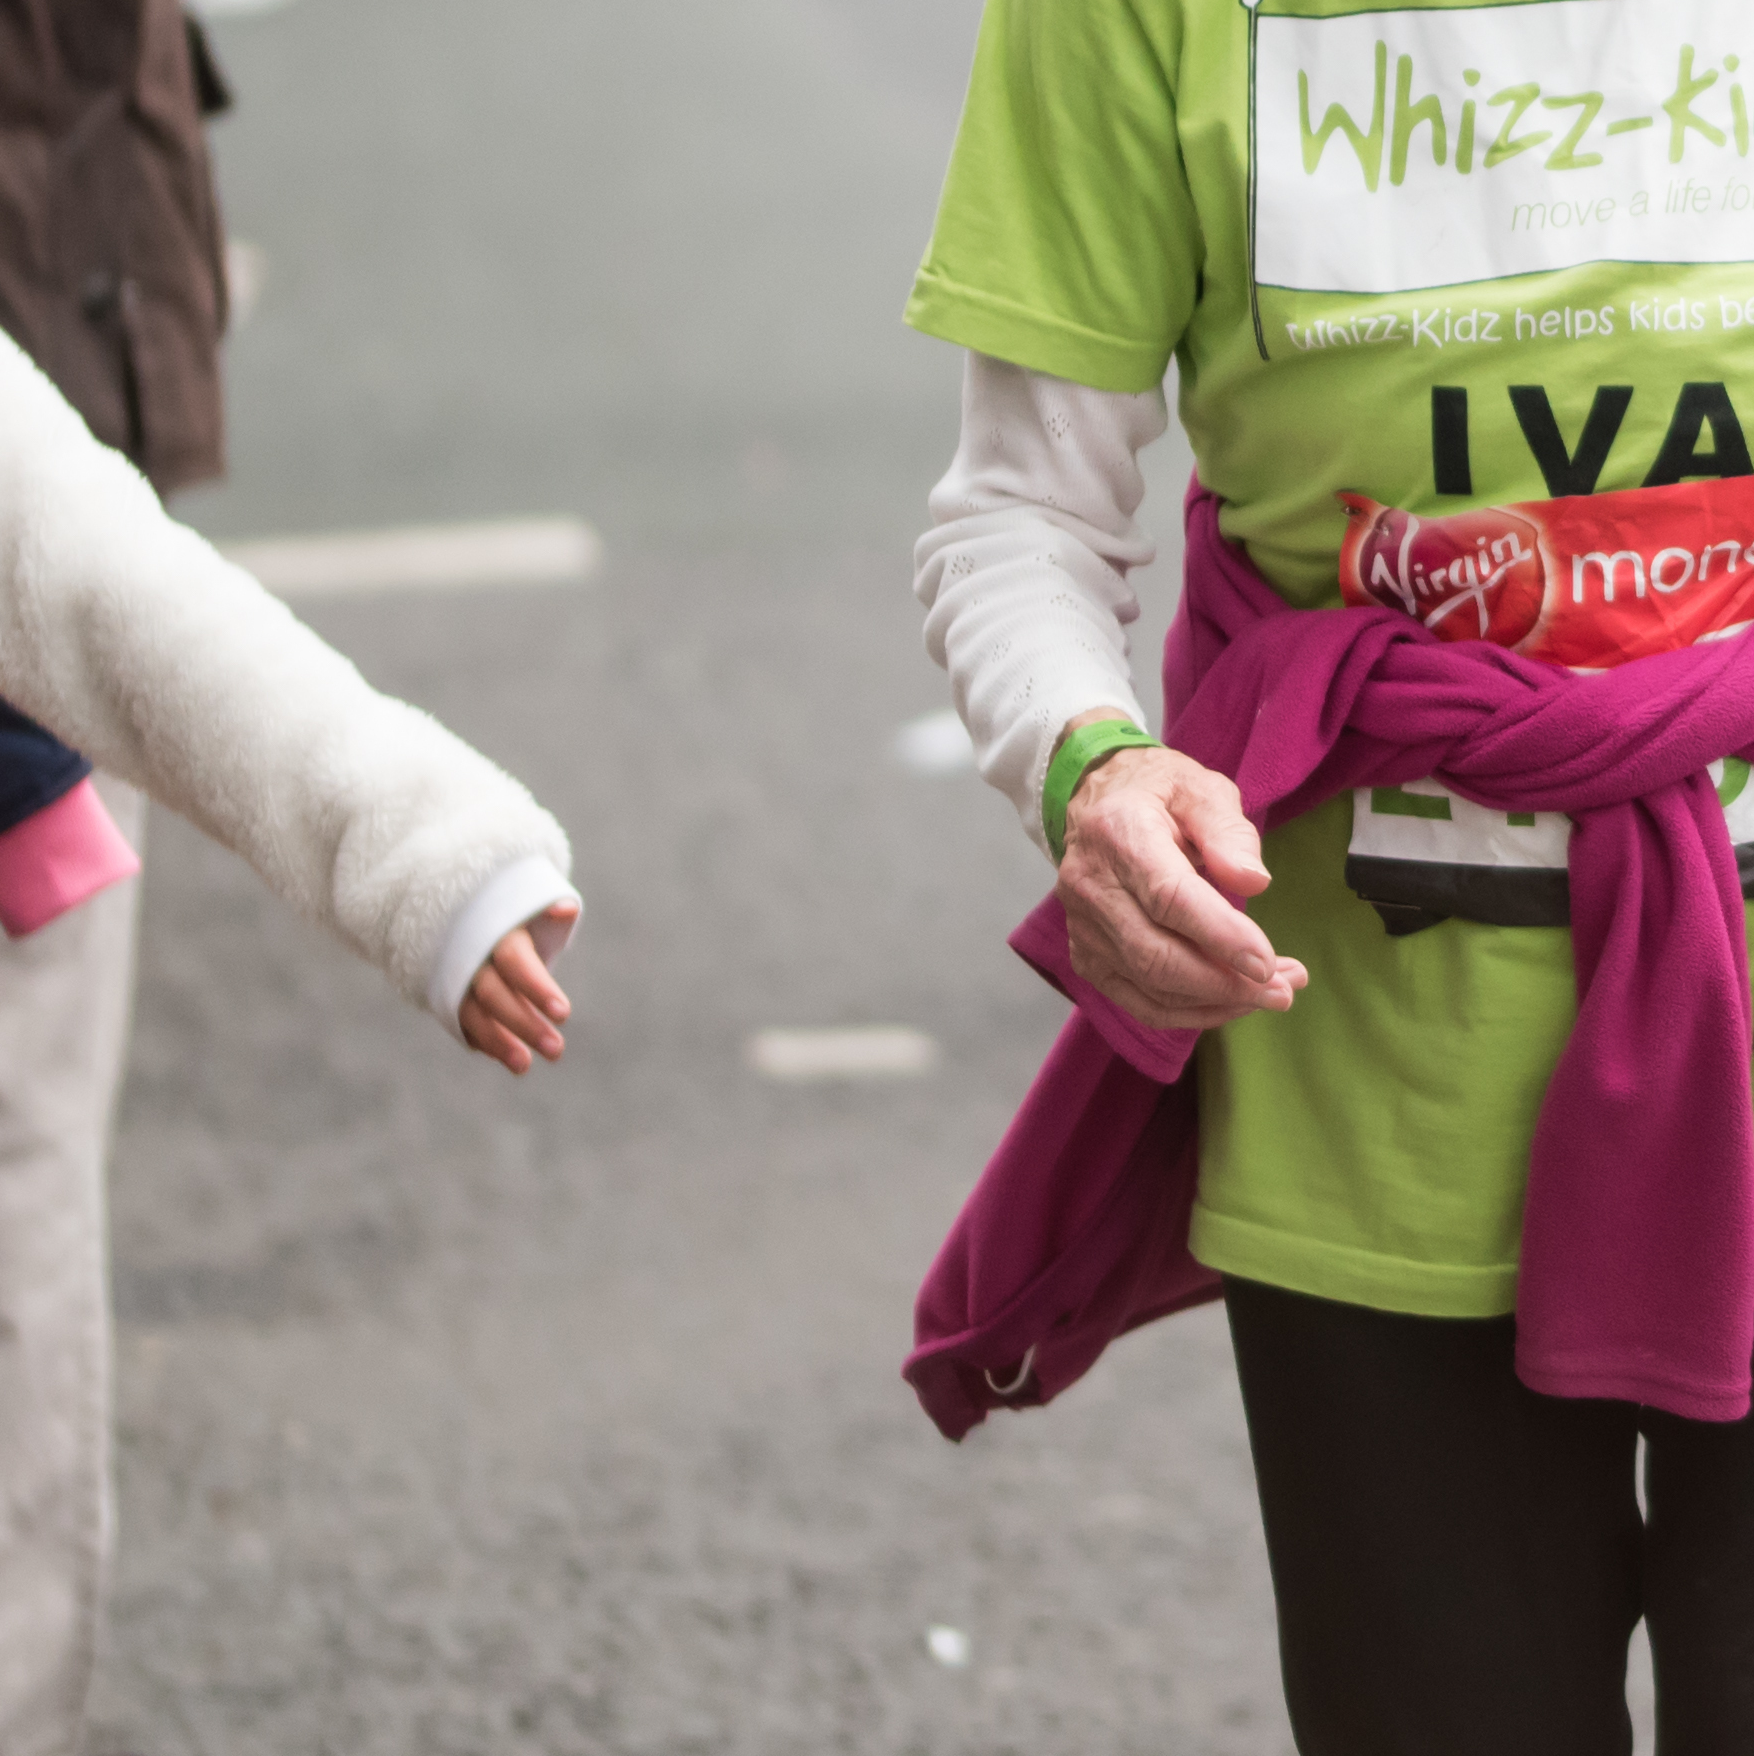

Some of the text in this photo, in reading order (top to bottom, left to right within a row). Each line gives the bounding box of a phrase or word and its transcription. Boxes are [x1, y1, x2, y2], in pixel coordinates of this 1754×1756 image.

[1510, 195, 1617, 233] move
[1627, 189, 1651, 218] a
[1664, 176, 1713, 215] life
[1285, 306, 1502, 351] Whizz-Kidz
[1514, 304, 1616, 342] helps
[1430, 380, 1754, 498] IVA
[1369, 512, 1534, 640] Virgin
